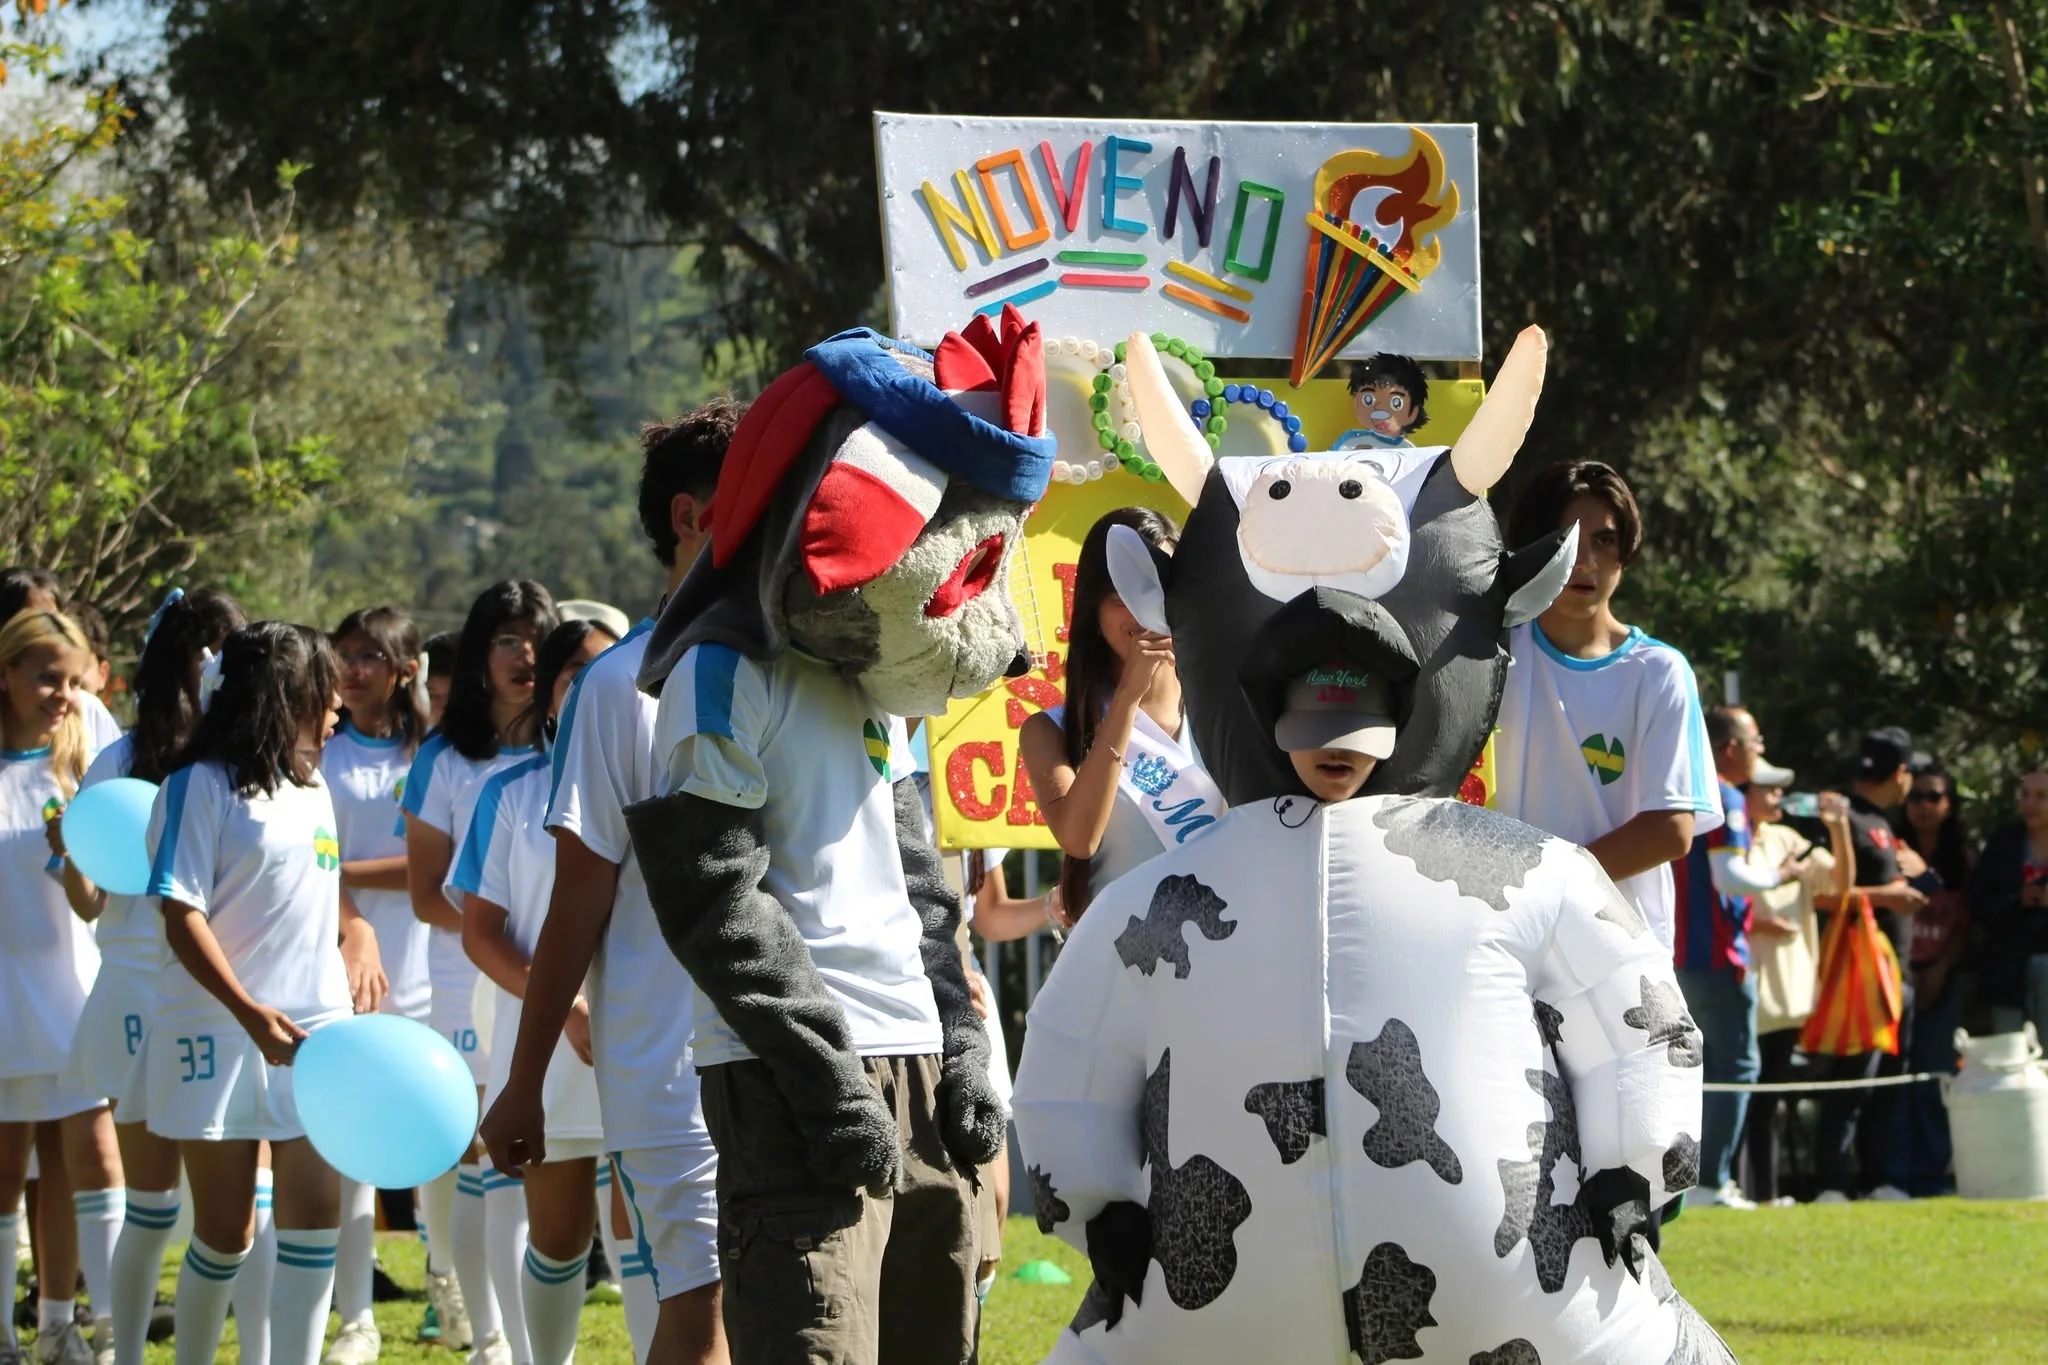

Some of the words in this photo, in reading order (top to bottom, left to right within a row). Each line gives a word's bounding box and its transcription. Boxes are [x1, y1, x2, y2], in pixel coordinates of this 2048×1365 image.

[921, 135, 1285, 283] NOVENO
[1306, 668, 1334, 685] New
[1336, 669, 1369, 688] York
[176, 1035, 216, 1082] 33
[453, 1029, 478, 1053] 10
